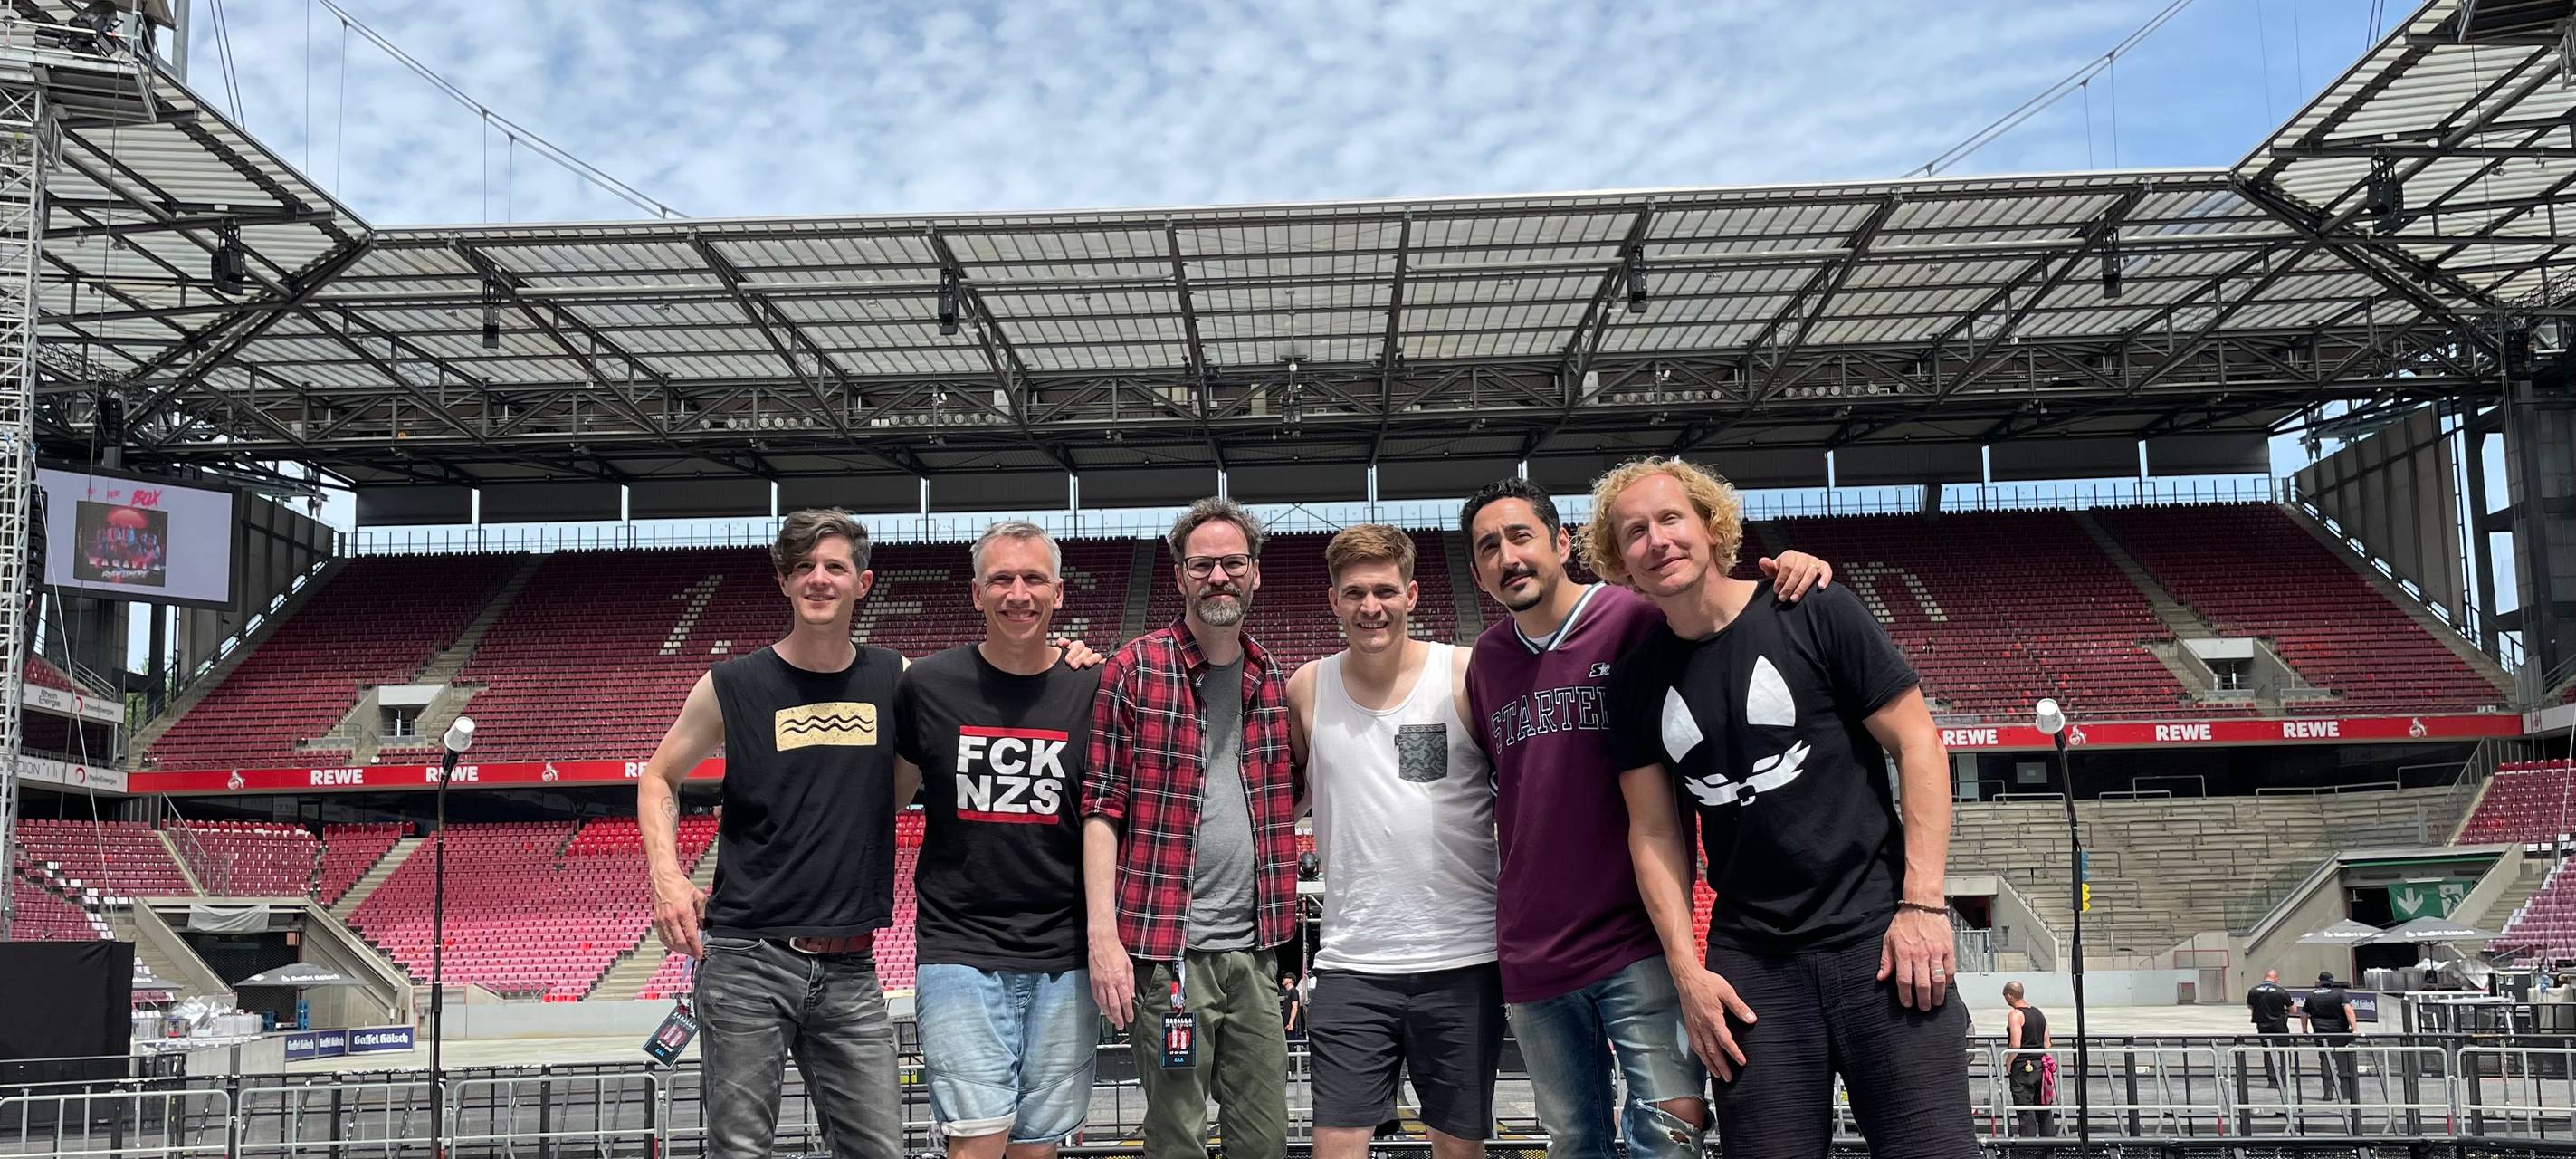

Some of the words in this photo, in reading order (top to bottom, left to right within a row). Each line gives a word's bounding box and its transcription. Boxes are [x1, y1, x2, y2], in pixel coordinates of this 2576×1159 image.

[1942, 729, 1999, 746] REWE
[2155, 724, 2212, 742] REWE
[2283, 721, 2340, 738] REWE
[956, 734, 1068, 779] FCK
[310, 768, 364, 786] REWE
[955, 773, 1063, 815] NZS
[354, 1034, 378, 1045] Gaffel
[380, 1032, 409, 1044] Kölsch
